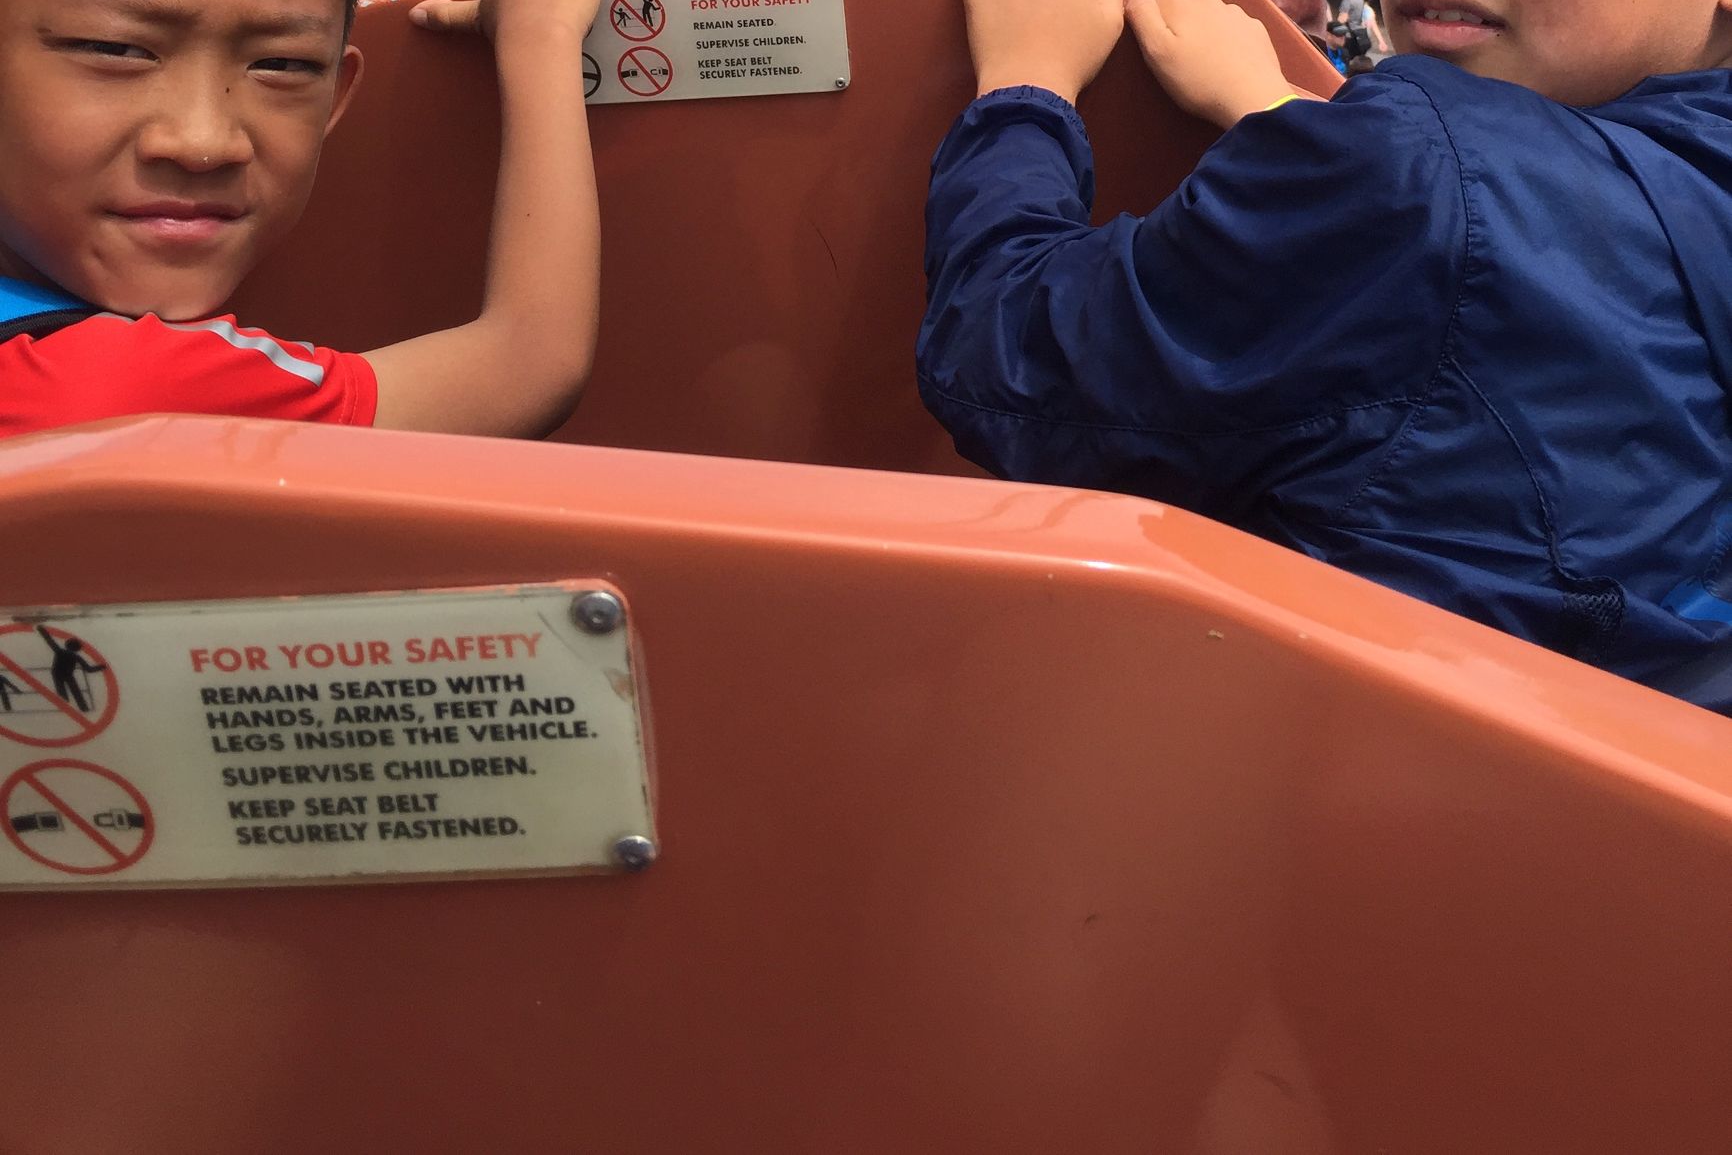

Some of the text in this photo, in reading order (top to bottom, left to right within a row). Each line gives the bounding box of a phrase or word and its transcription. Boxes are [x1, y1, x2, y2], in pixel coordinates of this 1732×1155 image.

[691, 0, 717, 10] FOR
[693, 21, 734, 30] REMAIN
[696, 36, 806, 49] SUPERVISE CHILDREN.
[700, 66, 802, 79] SECURELY FASTENED.
[725, 58, 747, 66] SEAT
[750, 57, 772, 65] BELT
[190, 632, 543, 673] FOR YOUR SAFETY
[200, 674, 526, 706] REMAIN SEATED WITH
[206, 696, 576, 729] HANDS, ARMS, FEET AND
[212, 719, 599, 753] LEGS INSIDE THE VEHICLE.
[222, 756, 537, 787] SUPERVISE CHILDREN.
[227, 793, 439, 819] KEEP SEAT BELT
[237, 817, 526, 845] SECURELY FASTENED.
